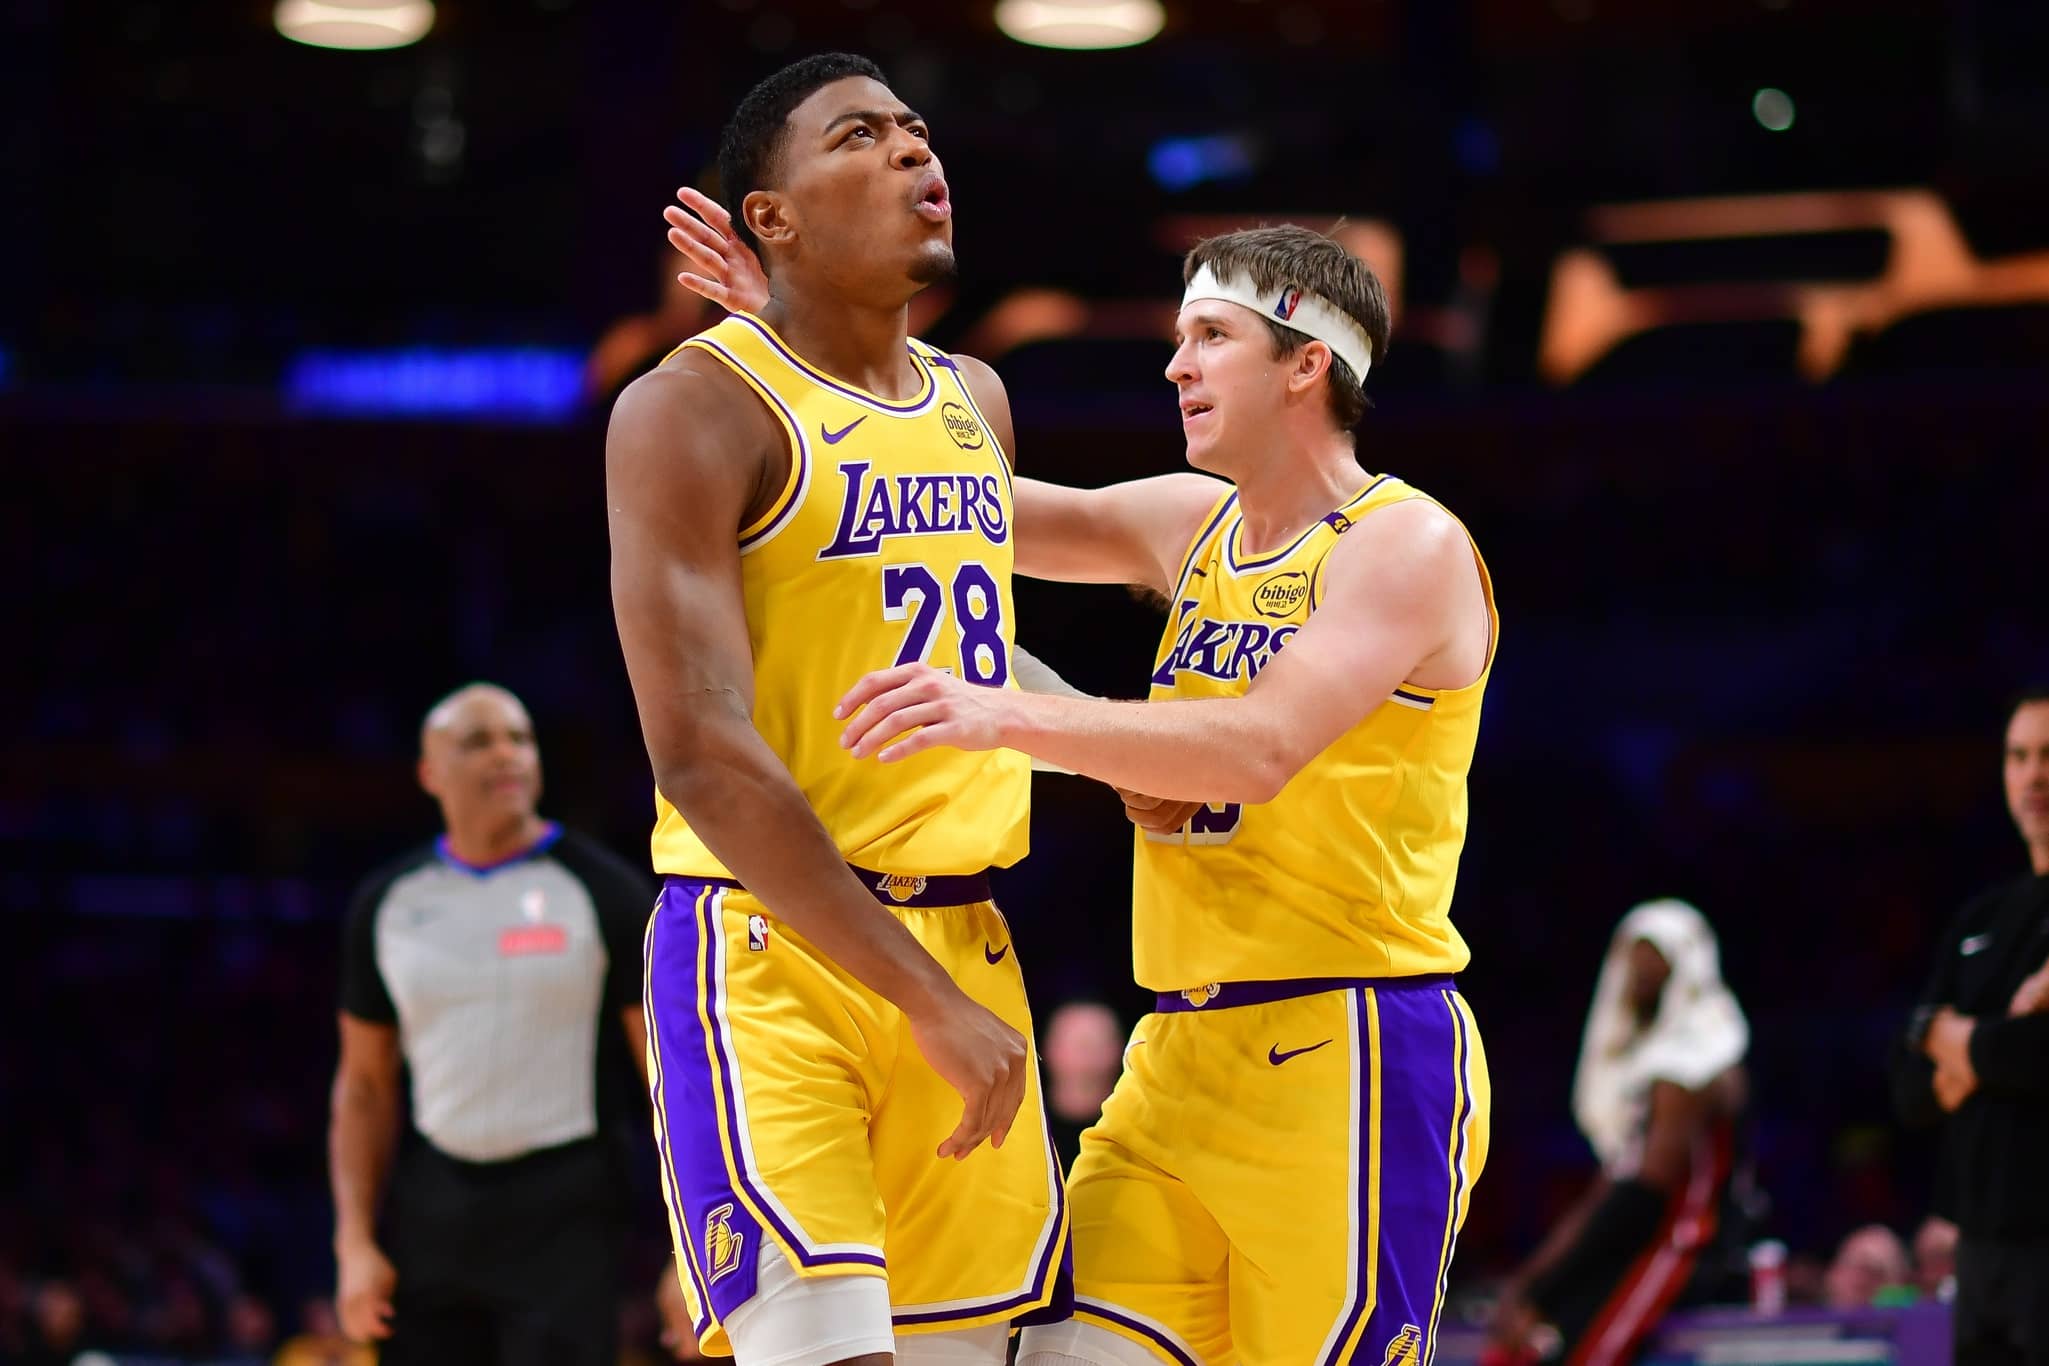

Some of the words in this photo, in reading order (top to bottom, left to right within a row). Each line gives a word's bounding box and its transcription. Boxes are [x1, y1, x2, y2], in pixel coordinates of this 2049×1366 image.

[944, 414, 979, 436] bibigo
[815, 459, 1008, 562] LAKERS
[881, 561, 1010, 689] 28
[1260, 584, 1306, 604] bibigo
[1150, 598, 1302, 688] LAKR
